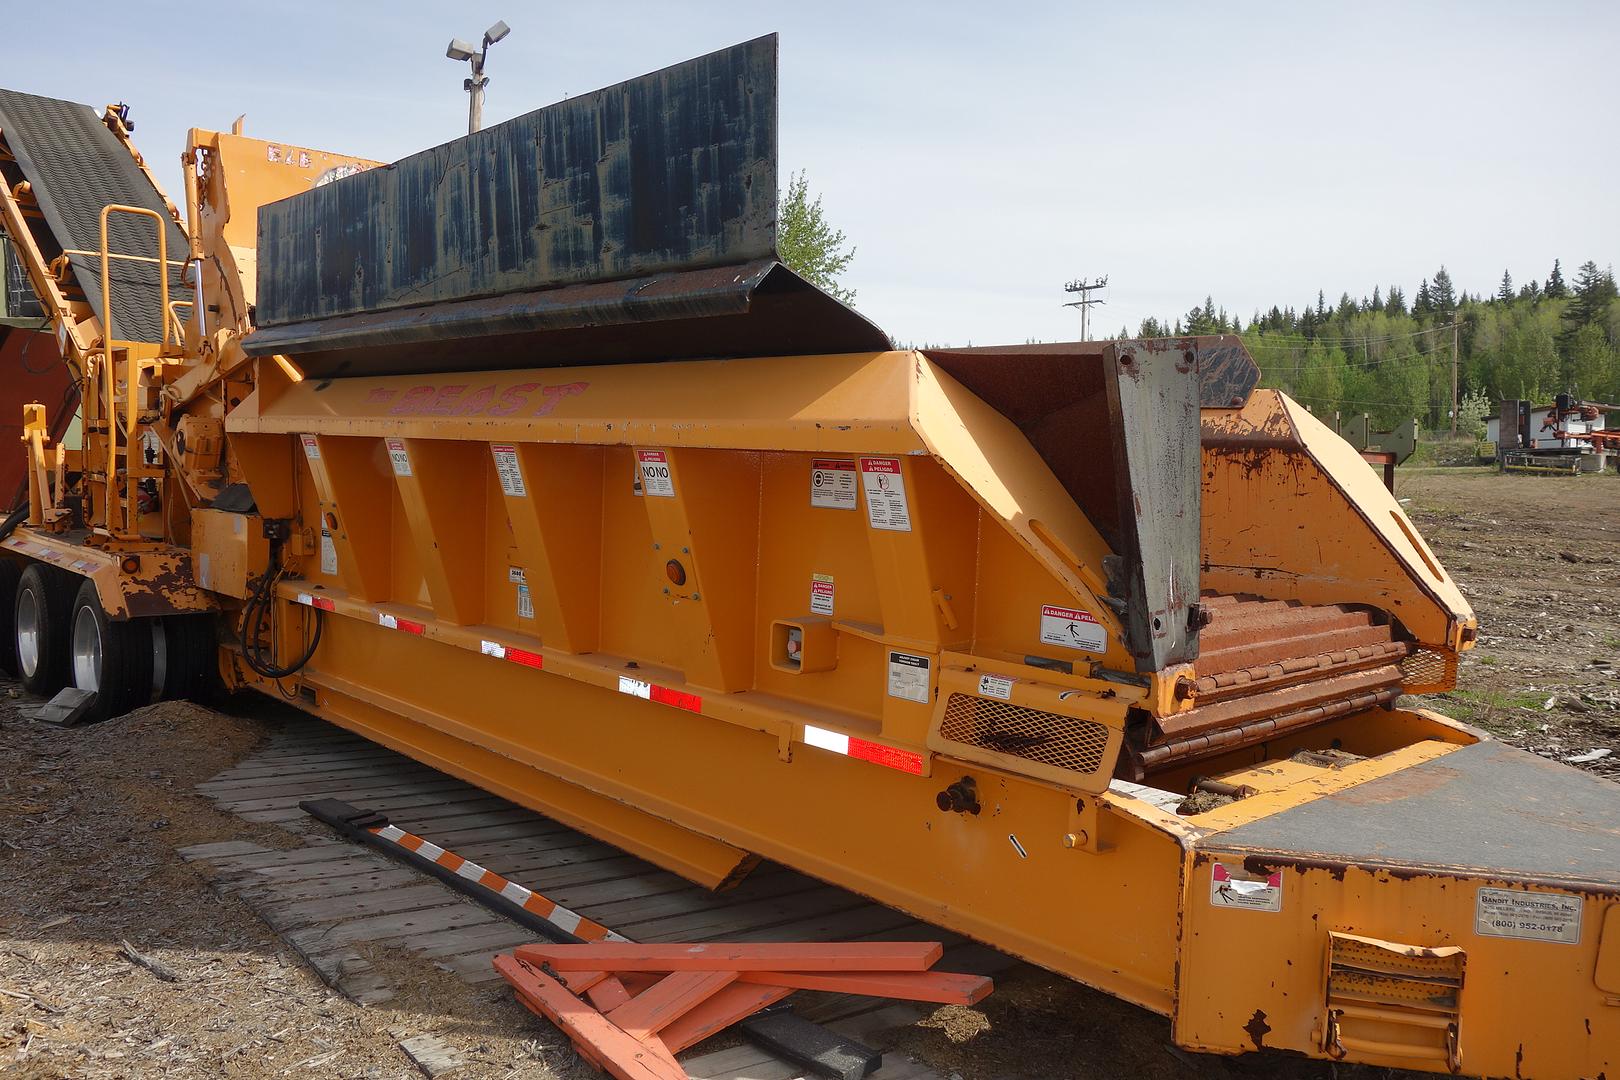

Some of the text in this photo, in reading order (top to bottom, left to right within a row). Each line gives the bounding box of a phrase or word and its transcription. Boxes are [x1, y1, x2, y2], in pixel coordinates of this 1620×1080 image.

[387, 381, 591, 416] BEAST
[1050, 610, 1074, 618] DANGER
[1491, 919, 1564, 933] (800) 952-0178
